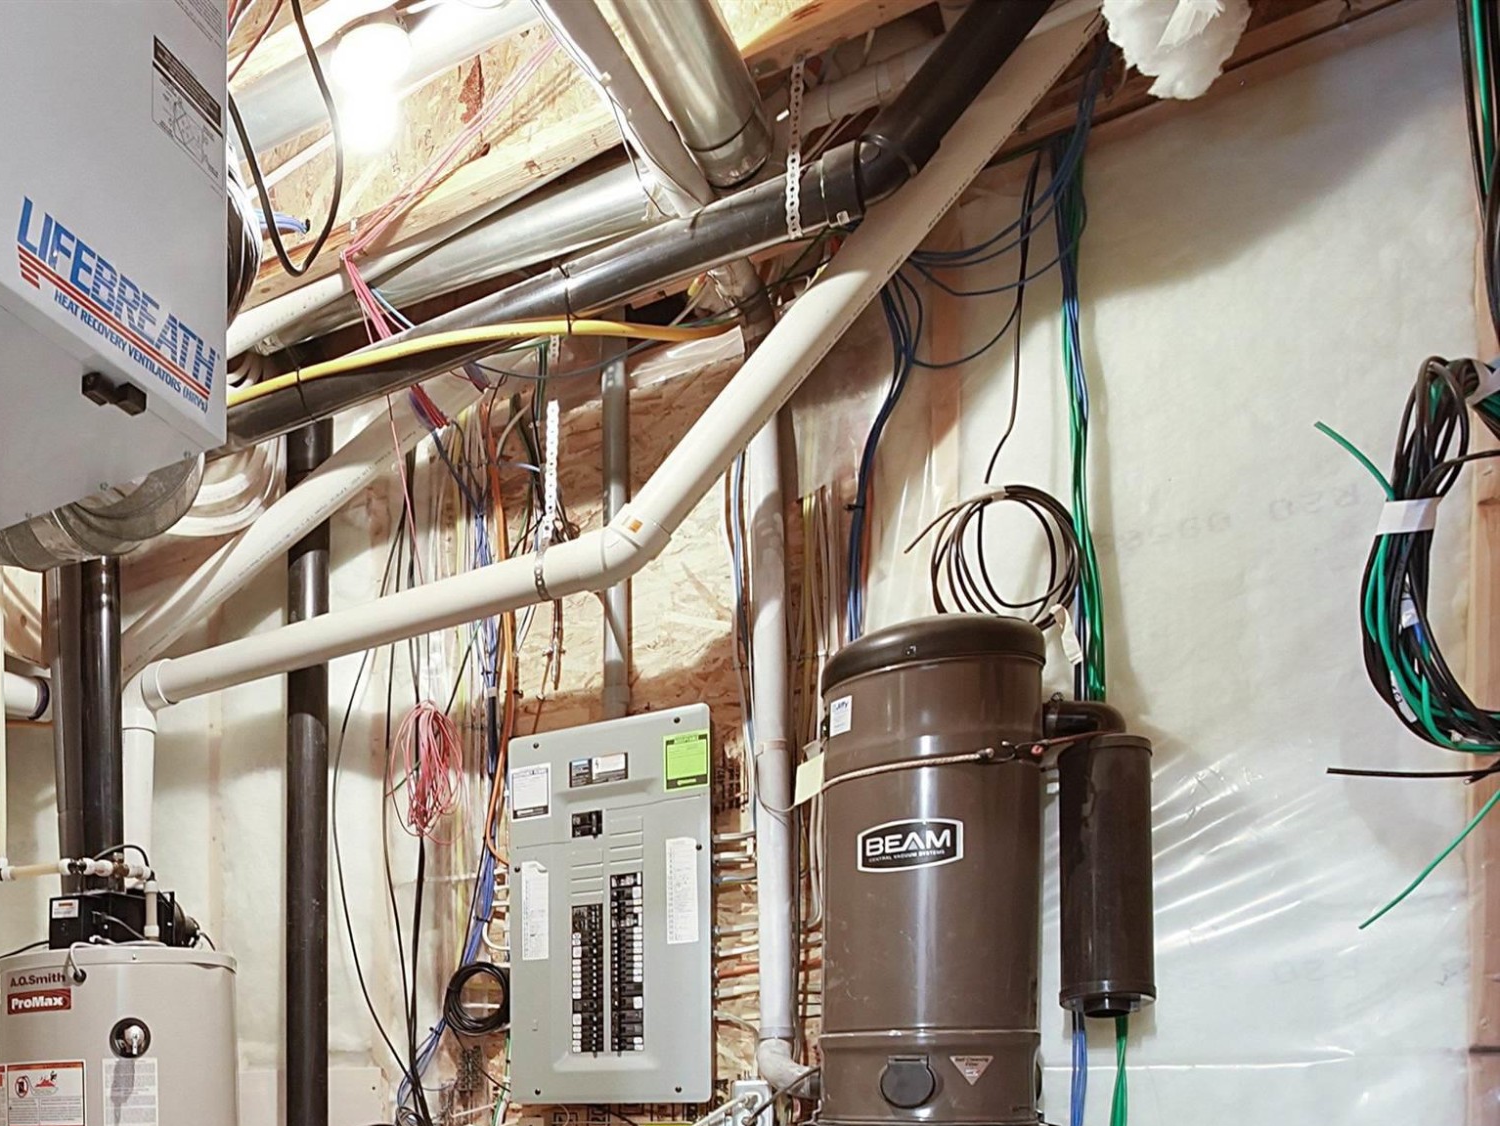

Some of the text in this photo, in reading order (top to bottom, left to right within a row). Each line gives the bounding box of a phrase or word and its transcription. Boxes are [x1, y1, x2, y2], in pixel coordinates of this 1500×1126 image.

[17, 195, 216, 390] LIFEBREATH
[54, 288, 79, 317] HEAT
[80, 309, 128, 353] RECOVERY
[128, 344, 182, 393] VENTILATORS
[865, 828, 951, 857] BEAM
[10, 972, 66, 988] A.O.Smith
[11, 996, 64, 1010] ProMax
